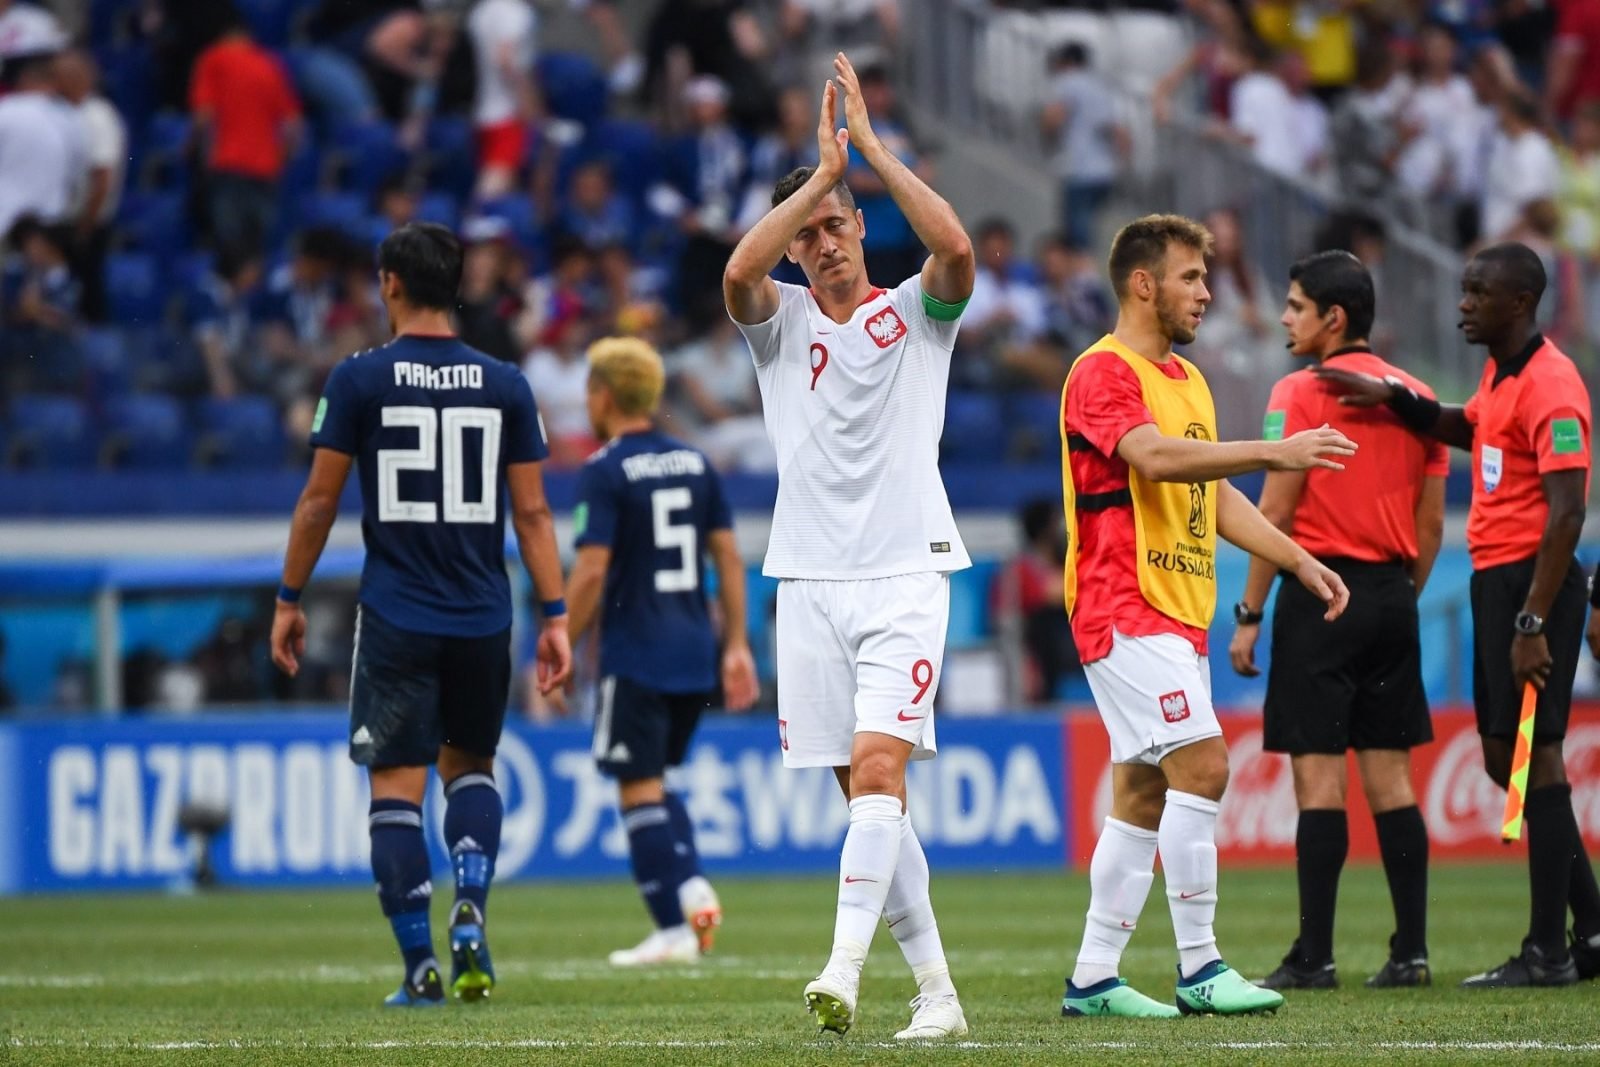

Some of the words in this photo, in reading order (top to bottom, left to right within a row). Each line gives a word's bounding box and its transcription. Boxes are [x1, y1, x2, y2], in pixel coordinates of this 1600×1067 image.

[393, 361, 483, 390] MAKINO
[810, 342, 829, 391] 9
[377, 406, 503, 524] 20
[651, 487, 698, 592] 5
[1147, 549, 1205, 577] RUSSIA
[911, 658, 934, 705] 9
